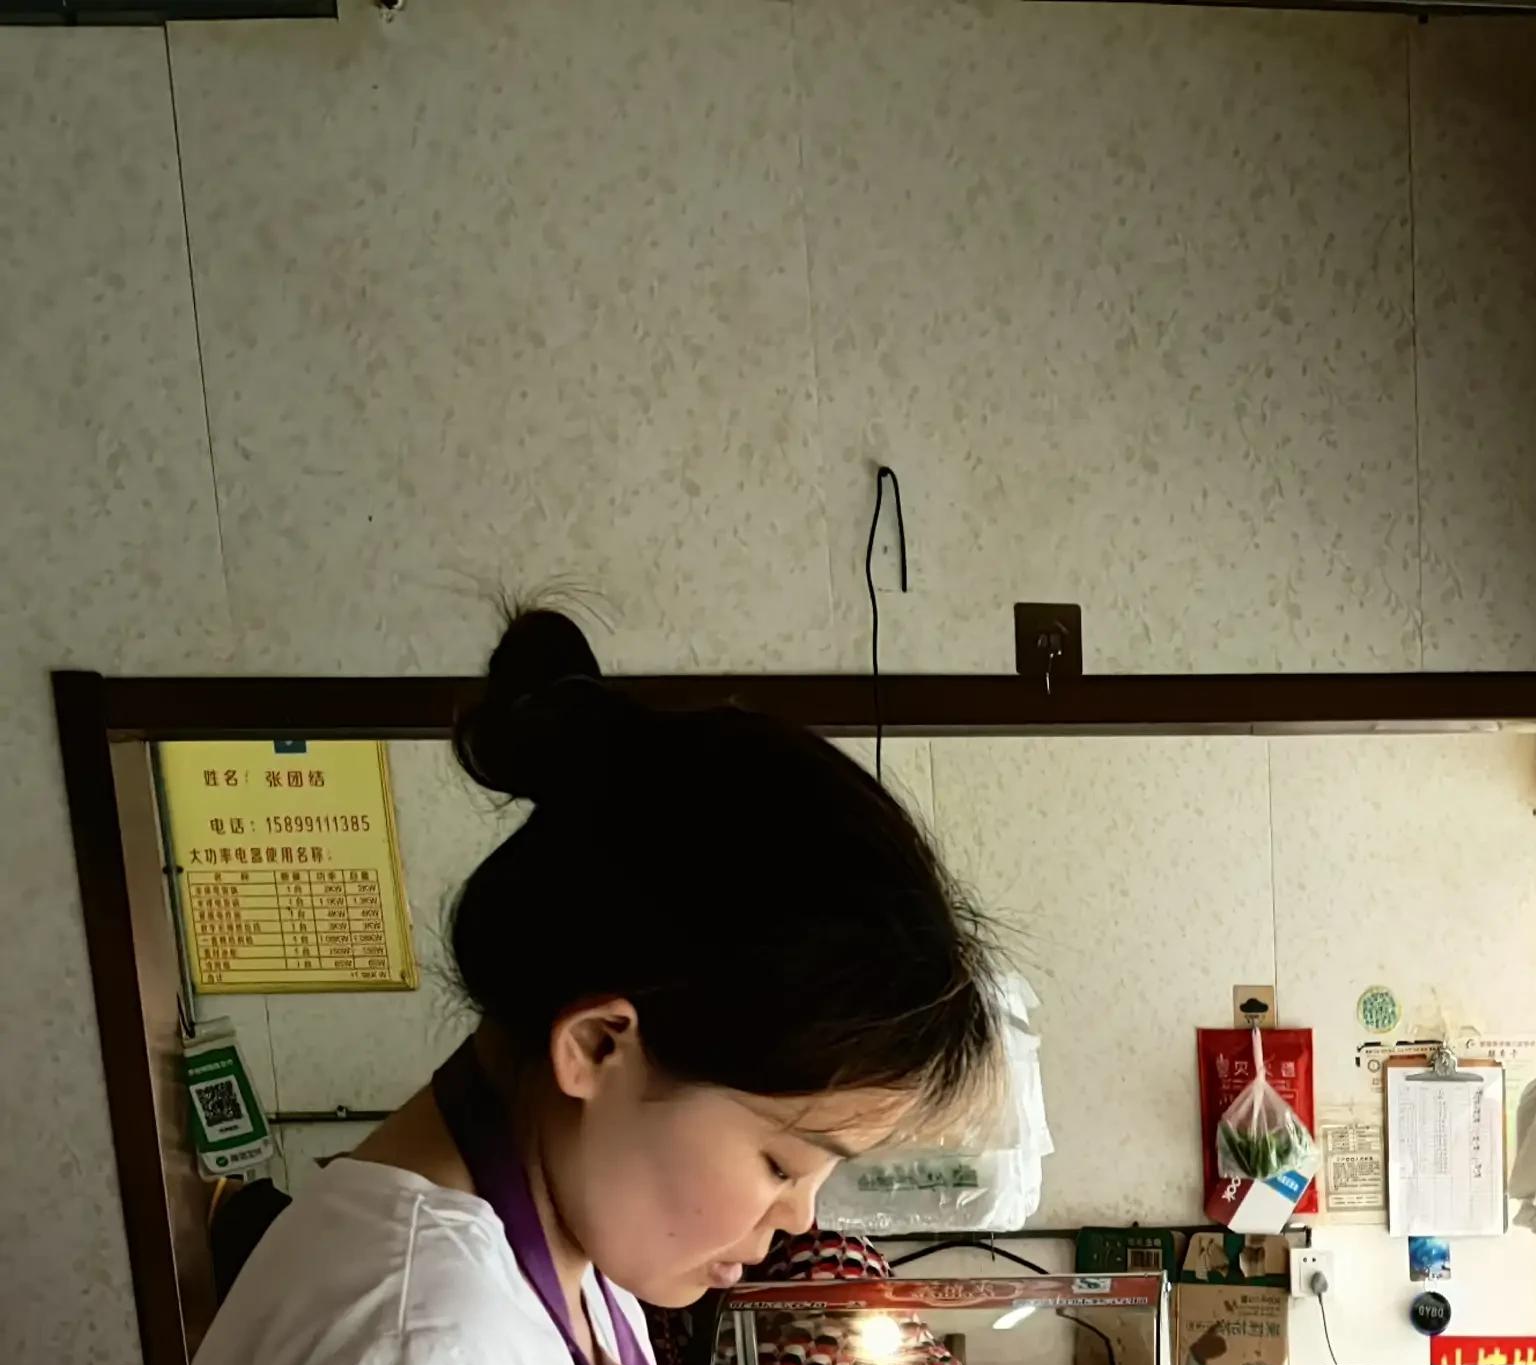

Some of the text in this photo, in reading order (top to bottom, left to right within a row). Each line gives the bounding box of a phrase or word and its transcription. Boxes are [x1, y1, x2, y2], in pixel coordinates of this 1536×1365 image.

[265, 770, 326, 788] 张团结
[266, 814, 371, 835] 15899111385
